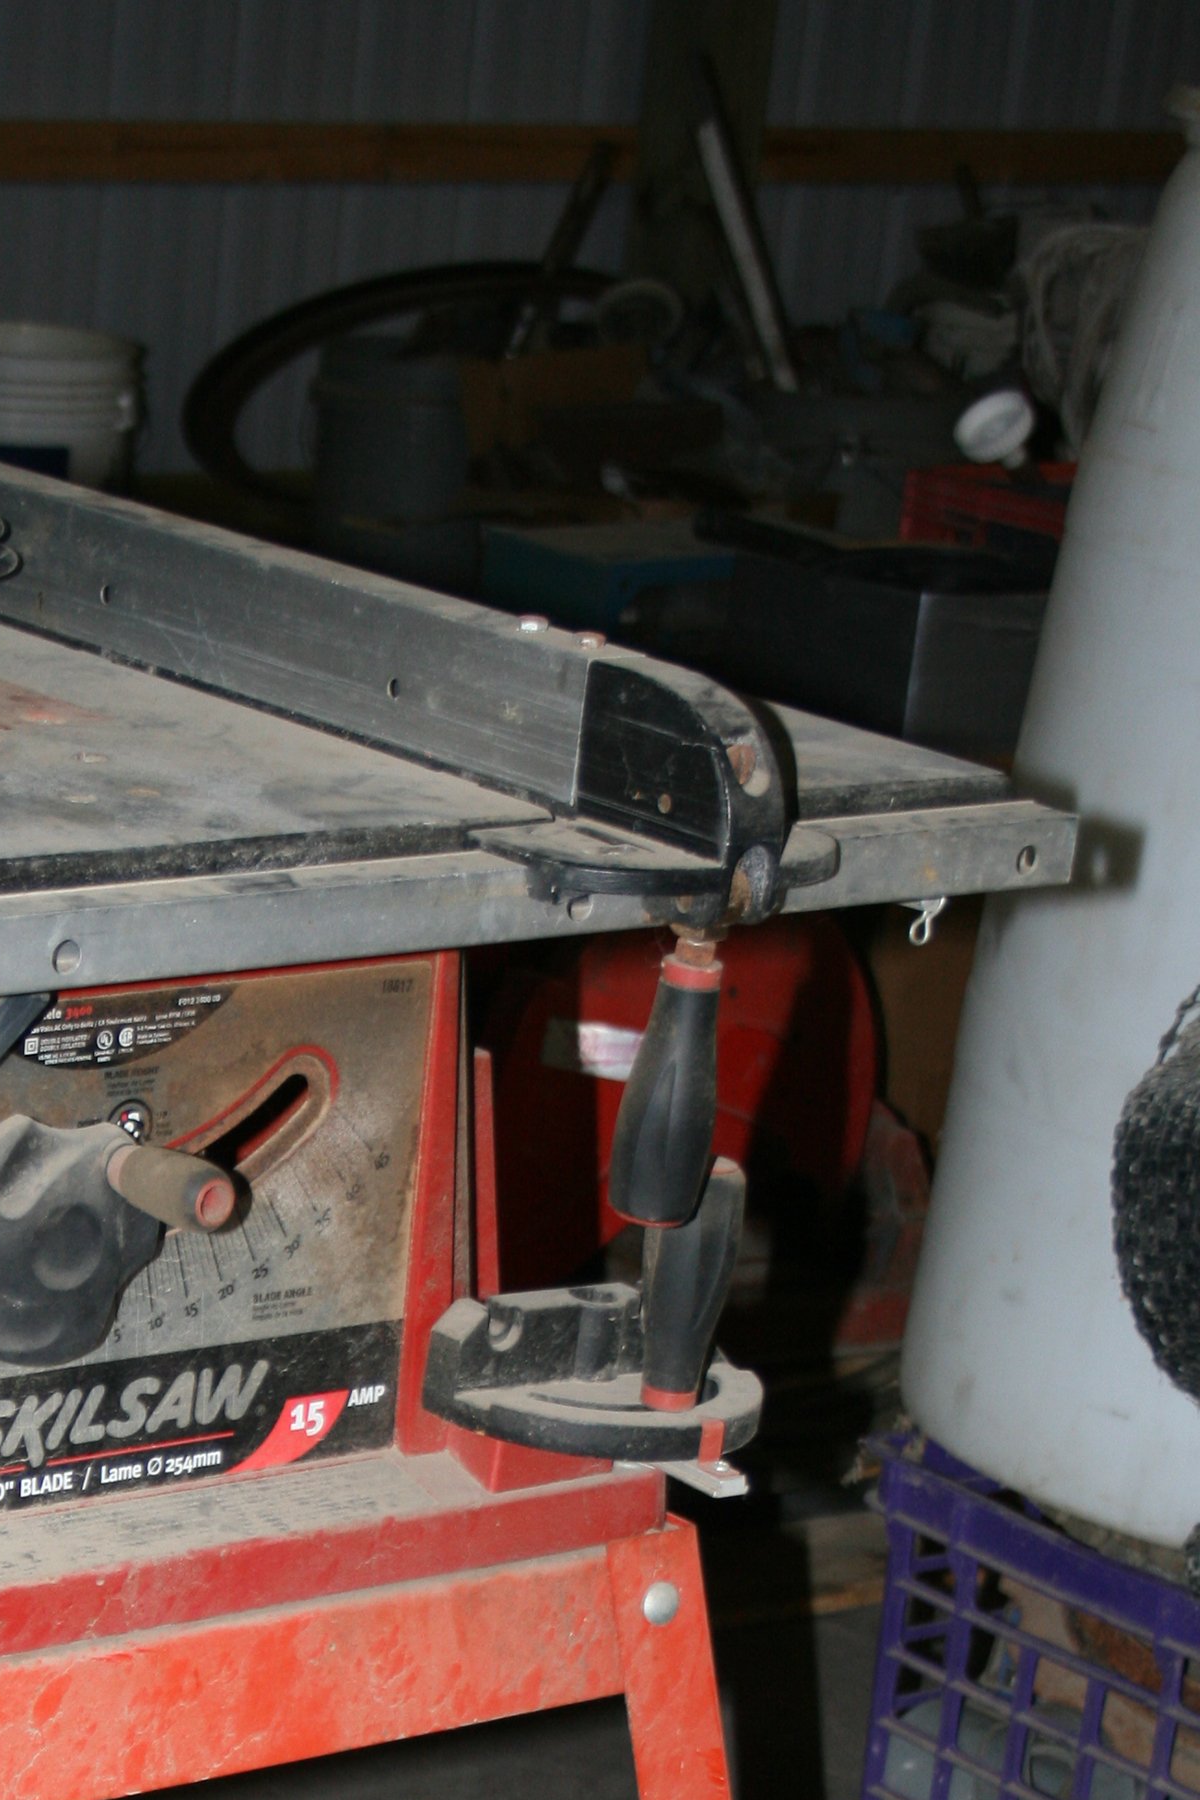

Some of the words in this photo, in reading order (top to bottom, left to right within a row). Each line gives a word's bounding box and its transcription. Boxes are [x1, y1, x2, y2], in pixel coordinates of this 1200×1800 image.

[290, 1400, 325, 1437] 15
[347, 1385, 386, 1408] AMP
[19, 1471, 74, 1498] BLADE
[100, 1463, 142, 1485] Lame
[165, 1450, 222, 1476] 254mm
